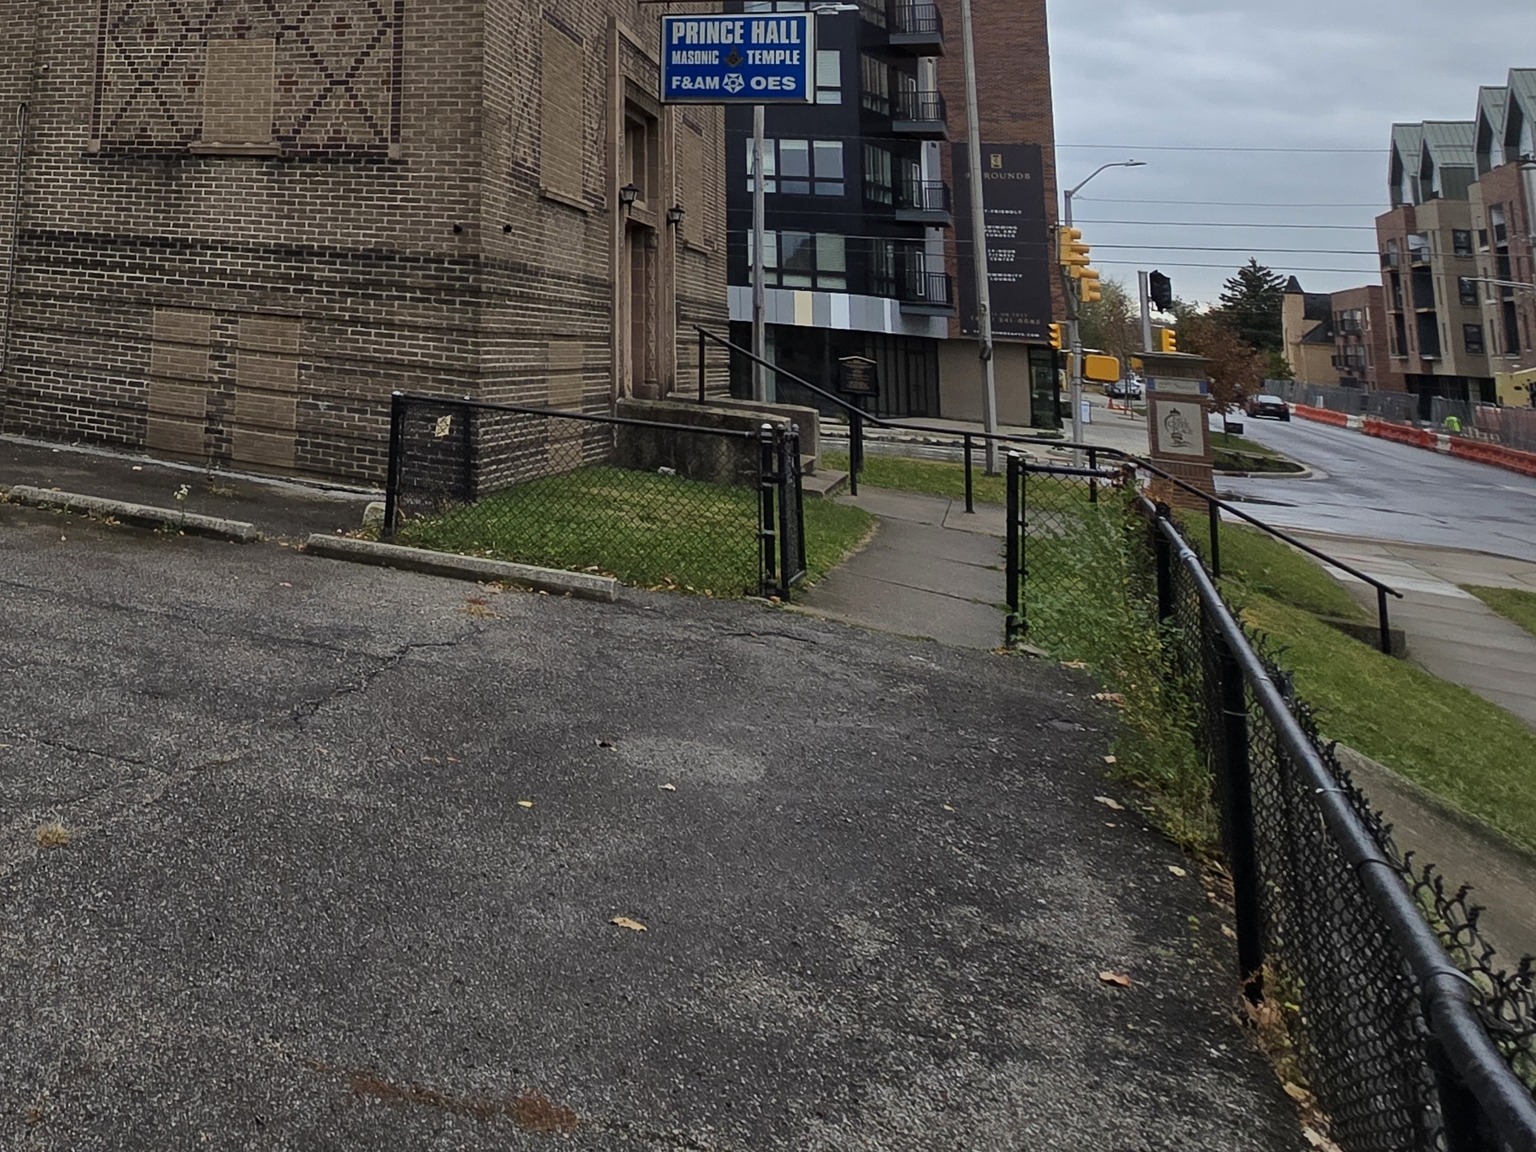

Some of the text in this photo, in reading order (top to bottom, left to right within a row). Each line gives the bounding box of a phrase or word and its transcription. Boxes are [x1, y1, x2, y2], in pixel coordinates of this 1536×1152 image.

[672, 20, 800, 45] PRINCE HALL
[671, 50, 800, 65] MASONIC TEMPLE
[671, 76, 797, 90] F&AM OES
[983, 172, 1031, 180] ROUNDS
